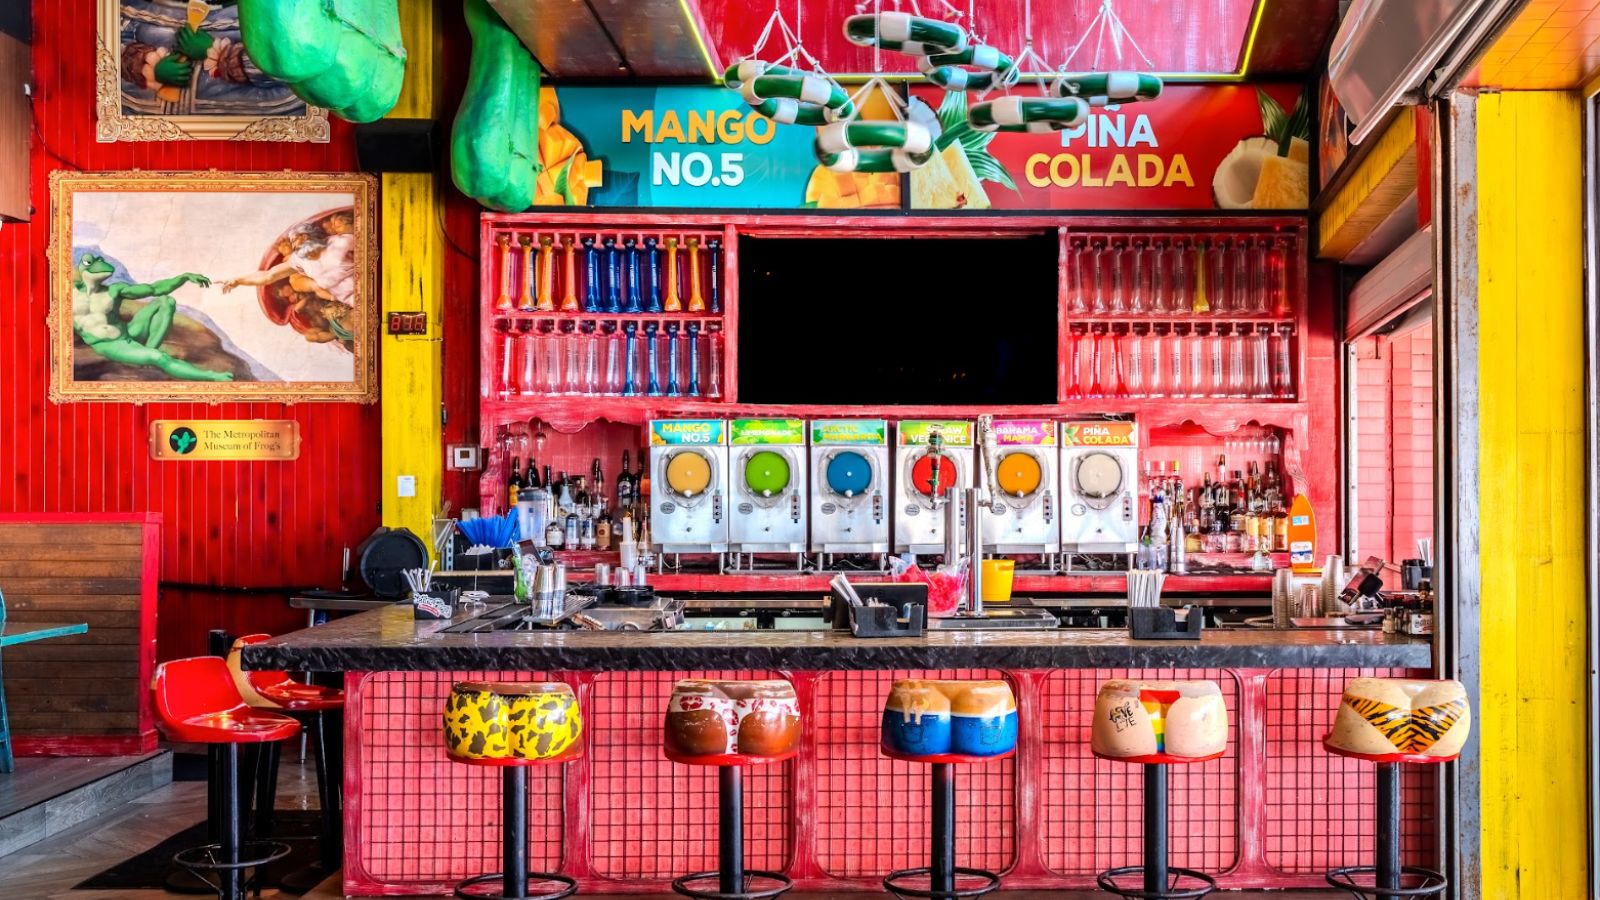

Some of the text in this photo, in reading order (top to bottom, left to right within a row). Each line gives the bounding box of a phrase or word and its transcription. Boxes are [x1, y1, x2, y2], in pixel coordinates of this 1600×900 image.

[621, 109, 776, 145] MANGO
[1060, 103, 1159, 148] PIÑA
[652, 152, 745, 187] NO.5
[1025, 153, 1195, 188] COLADA
[662, 423, 711, 433] MANGO
[996, 426, 1038, 435] BAHAMA
[1083, 425, 1110, 435] PIÑA
[203, 430, 280, 441] The Metropolitan
[681, 433, 710, 443] NO.5
[1083, 436, 1129, 445] COLADA
[203, 441, 281, 453] Museum of Frog's
